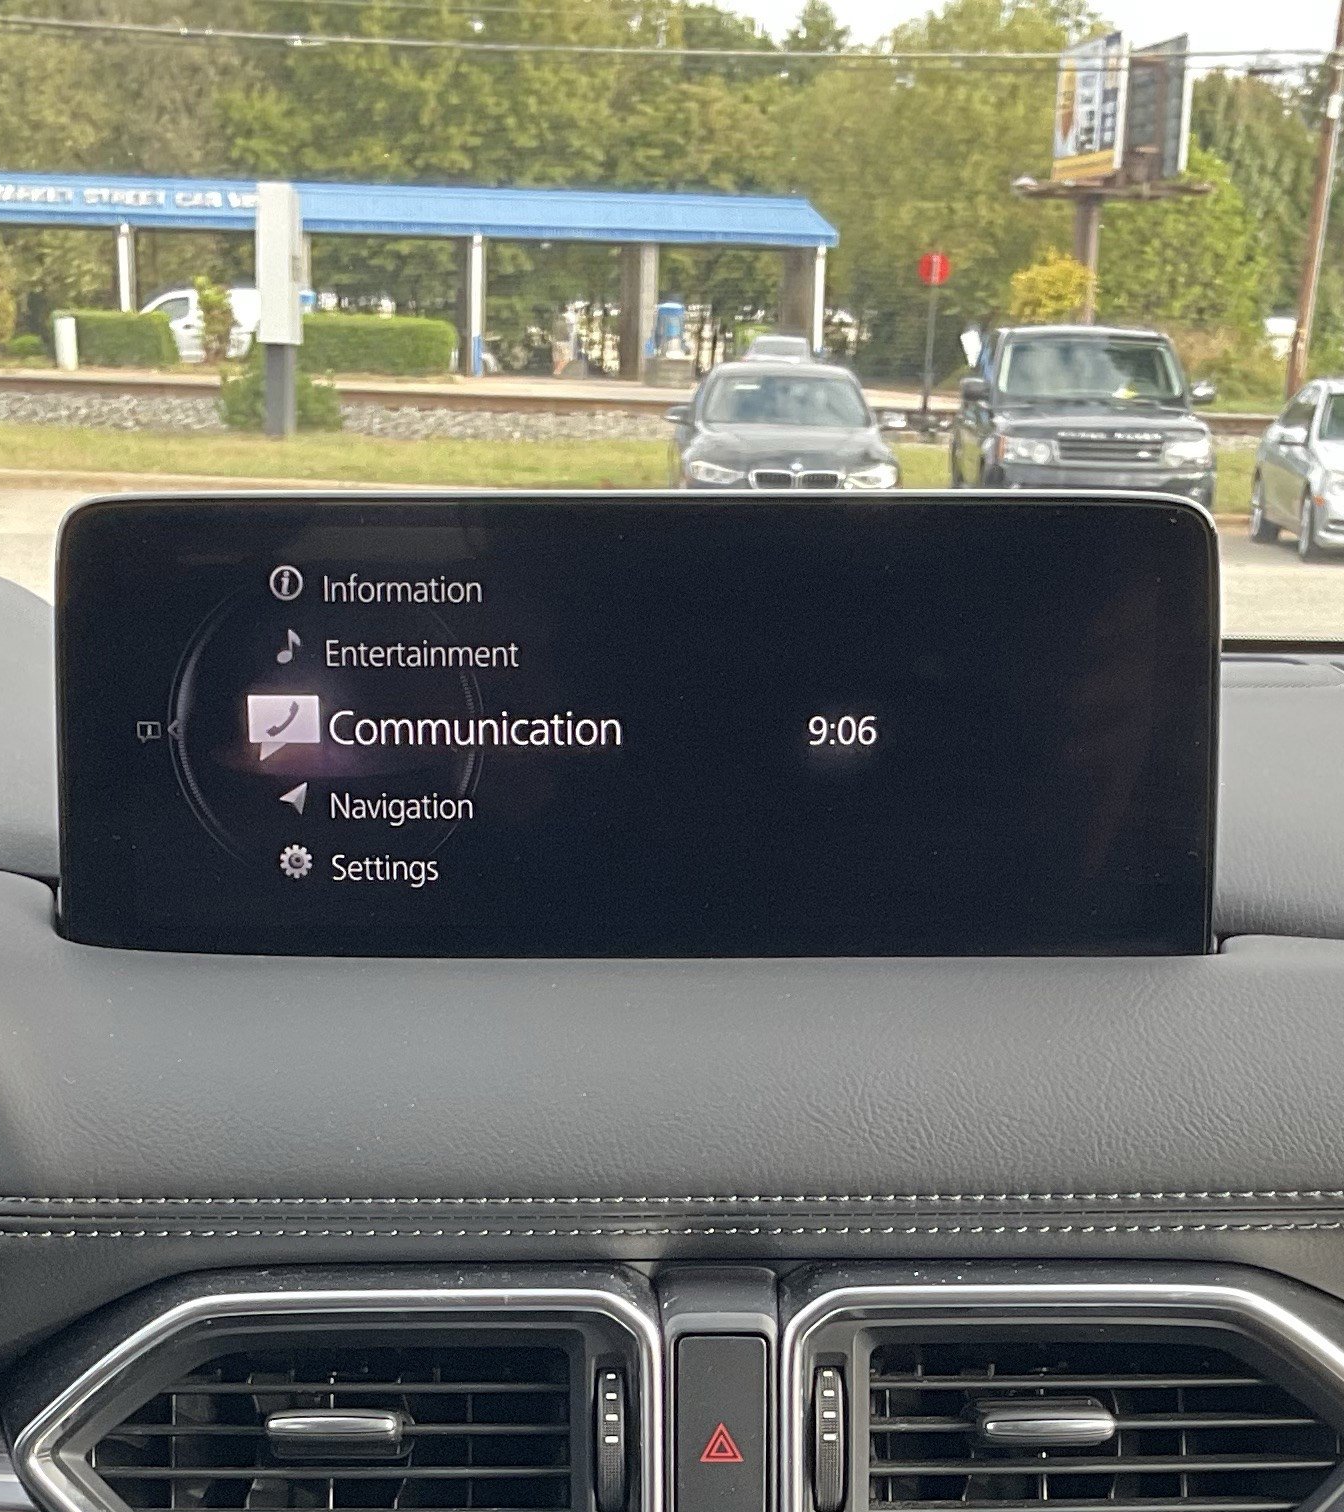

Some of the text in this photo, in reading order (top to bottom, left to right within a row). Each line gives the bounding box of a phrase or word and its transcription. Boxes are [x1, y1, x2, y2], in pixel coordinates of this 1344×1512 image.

[323, 572, 482, 603] Information
[326, 639, 519, 668] Entertainment
[329, 710, 622, 746] Communication
[808, 715, 877, 746] 9:06
[330, 792, 474, 827] Navigation
[331, 854, 439, 888] Settings
